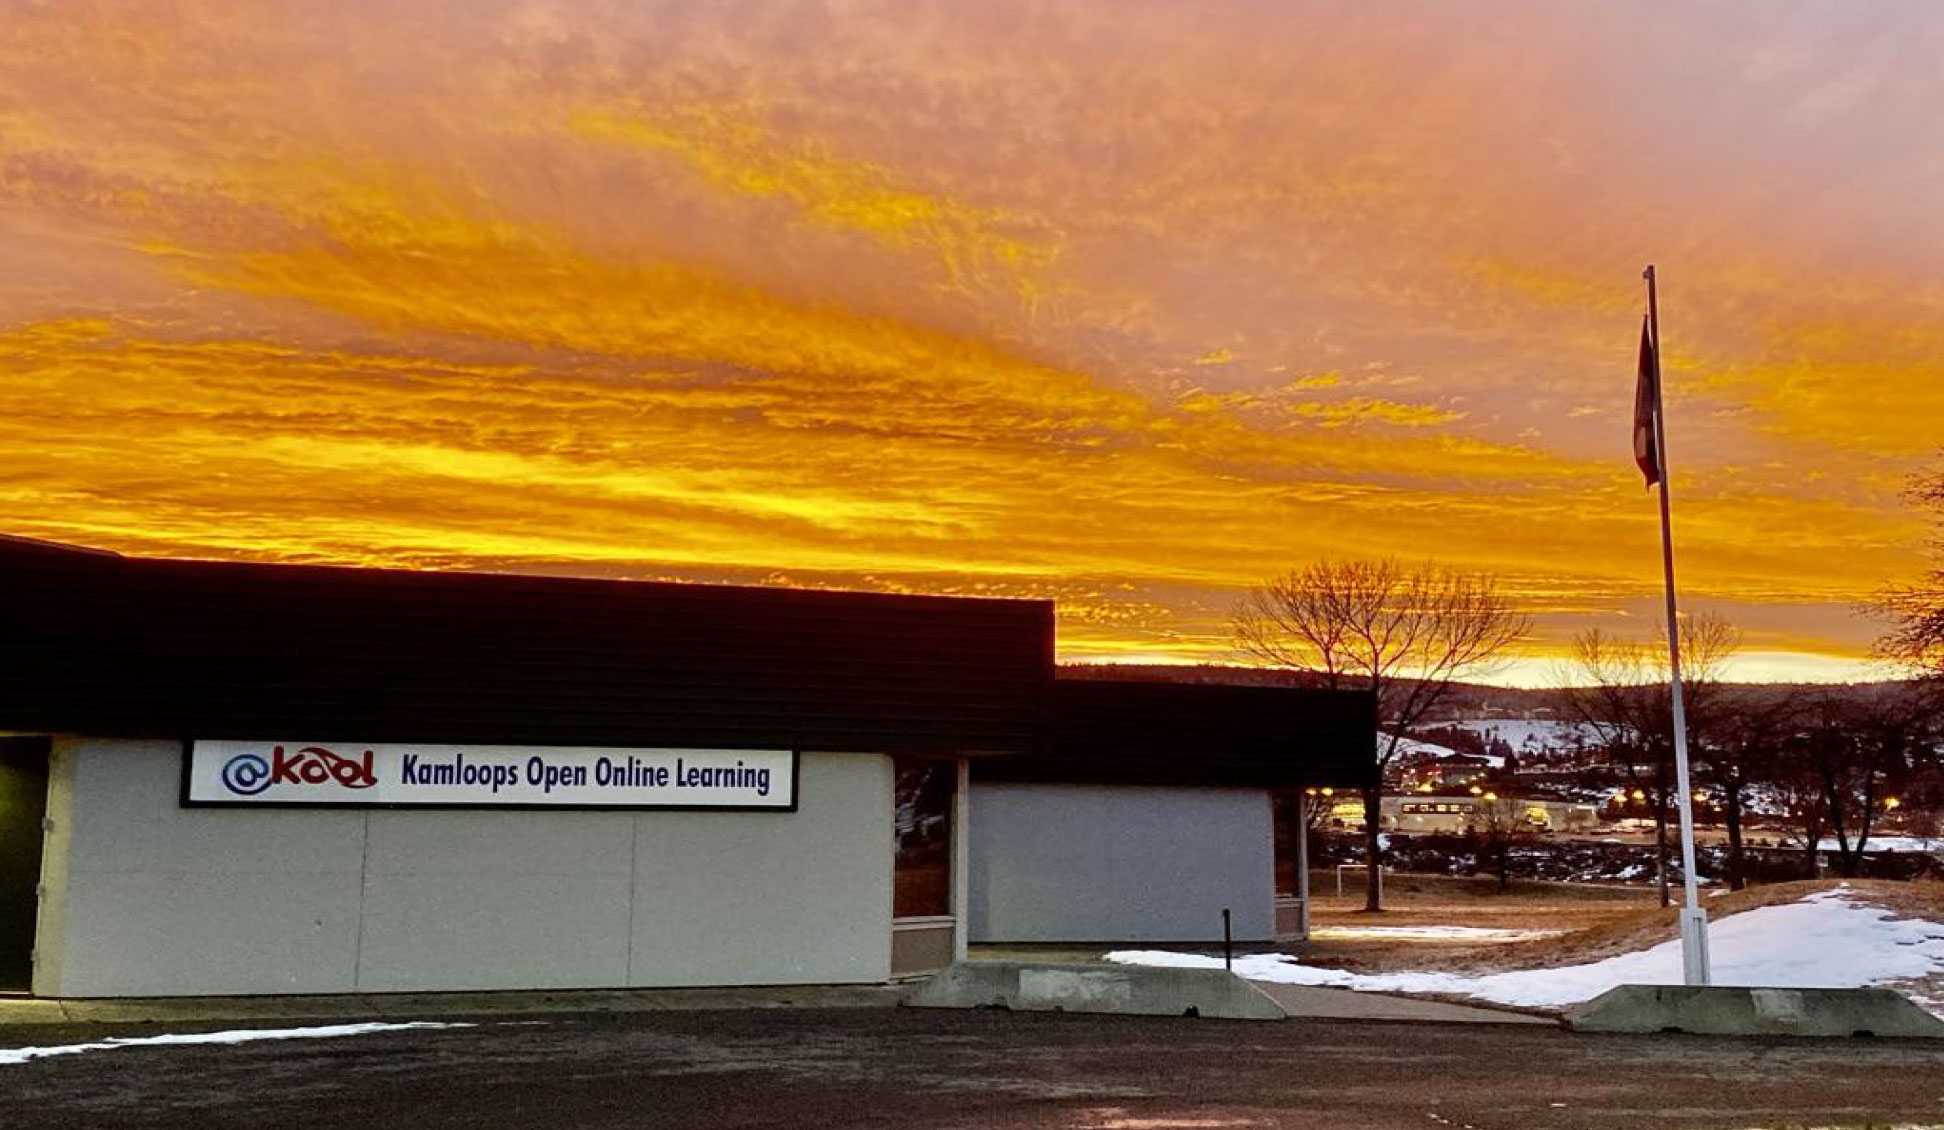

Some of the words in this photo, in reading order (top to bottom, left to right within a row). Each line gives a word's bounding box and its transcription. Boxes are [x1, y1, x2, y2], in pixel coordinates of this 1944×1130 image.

[401, 753, 518, 793] Kamloops
[527, 756, 587, 793] Open
[595, 755, 669, 788] Online
[676, 758, 770, 796] Learning
